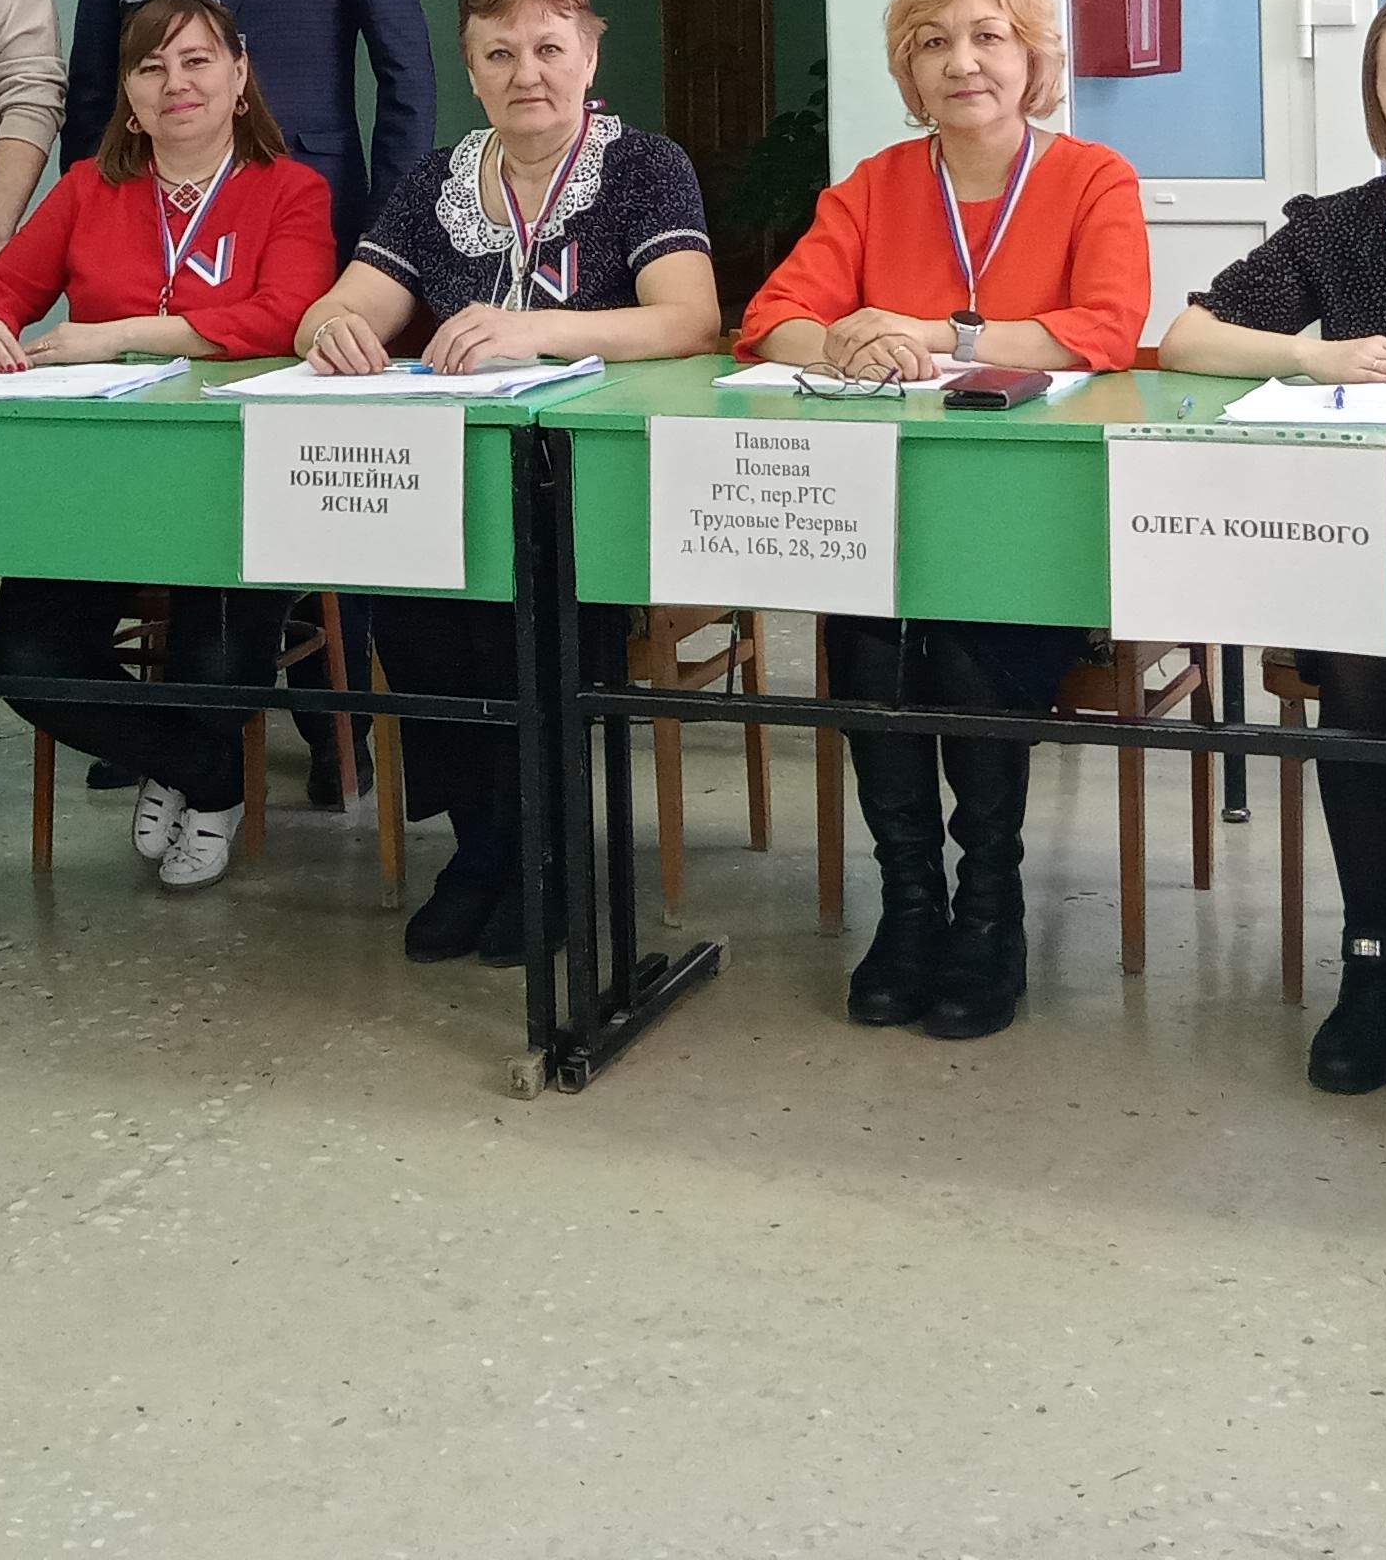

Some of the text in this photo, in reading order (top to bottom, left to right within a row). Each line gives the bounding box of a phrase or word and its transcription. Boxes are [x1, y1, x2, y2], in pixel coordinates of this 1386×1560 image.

[735, 432, 810, 450] Павлова
[301, 446, 410, 464] ЦЕЛИННАЯ
[736, 458, 810, 477] Полевая
[290, 468, 419, 490] ЮБИЛЕЙНАЯ
[321, 496, 388, 514] ЯСНАЯ
[712, 484, 836, 507] РТС, пер.РТС
[690, 509, 857, 536] Трудовые Резервы
[1132, 515, 1369, 545] ОЛЕГА КОШЕВОГО
